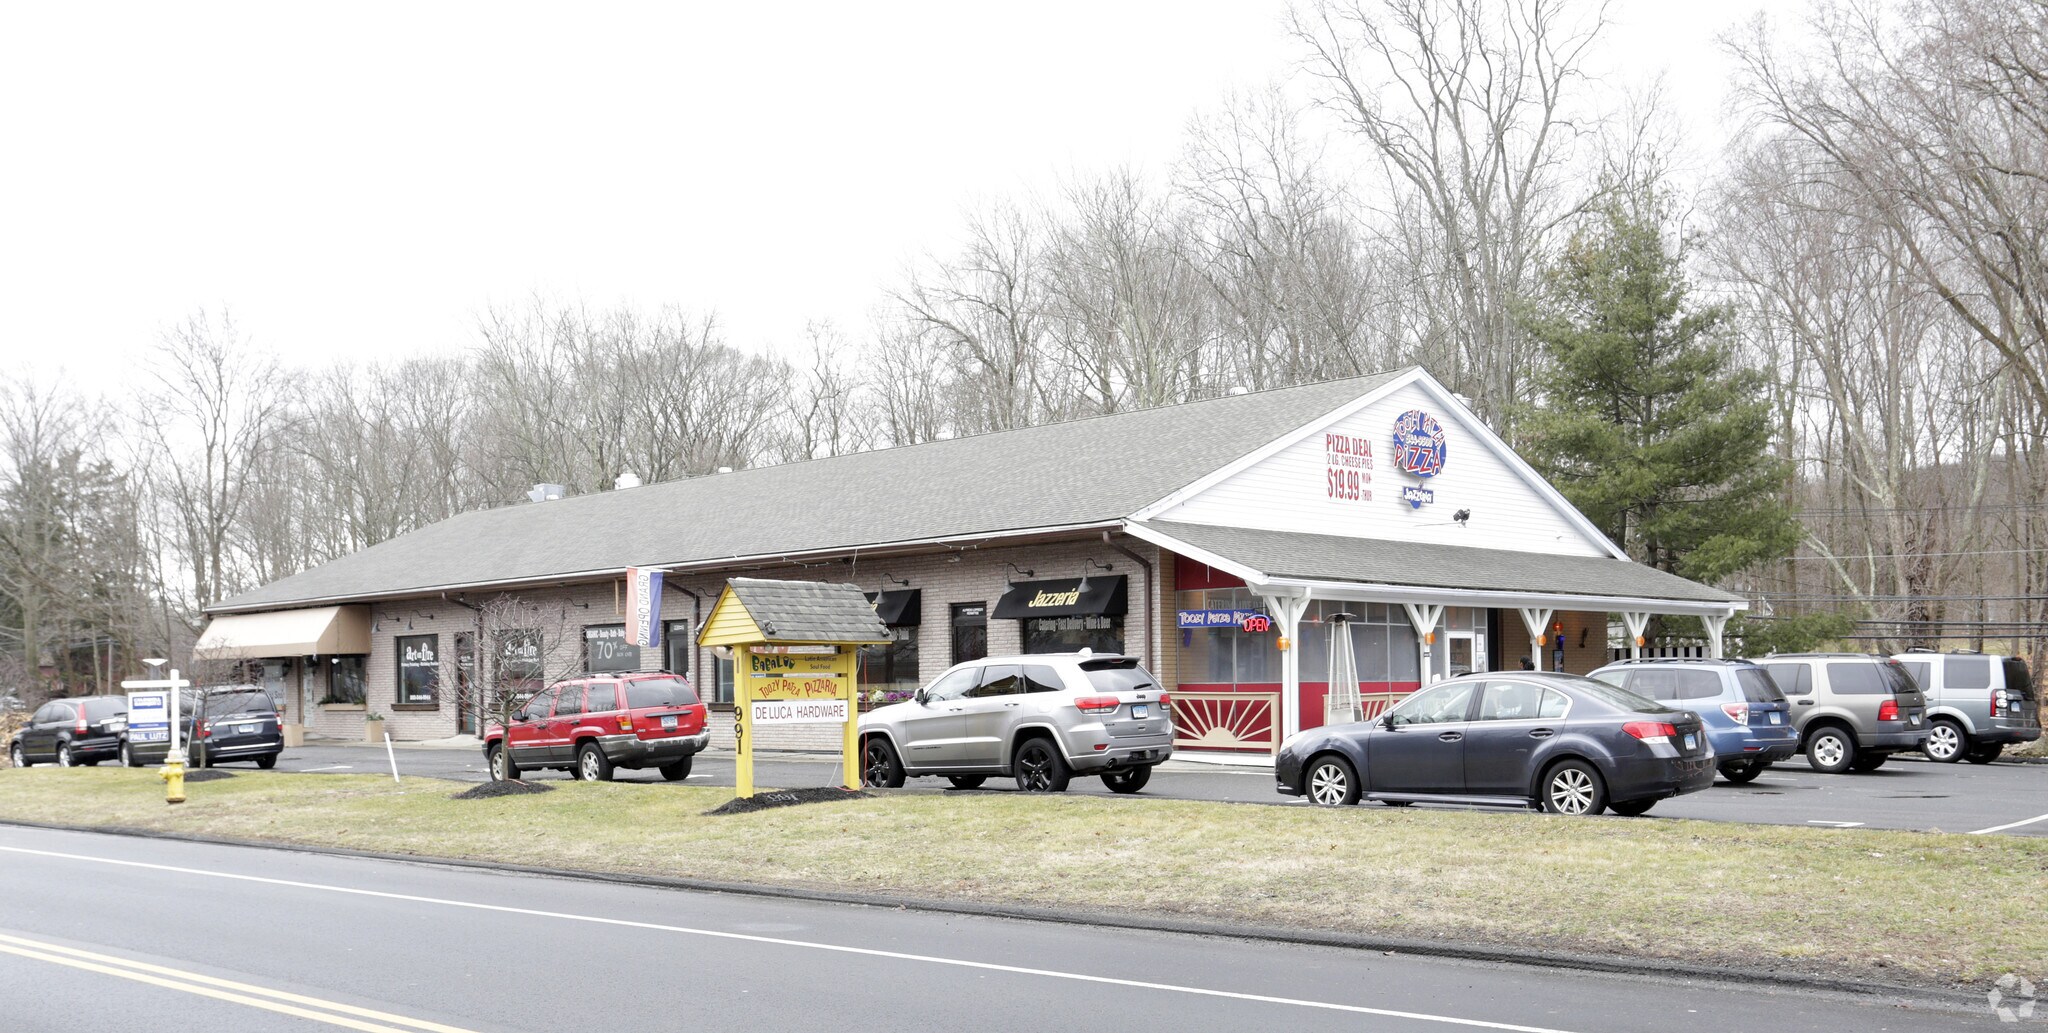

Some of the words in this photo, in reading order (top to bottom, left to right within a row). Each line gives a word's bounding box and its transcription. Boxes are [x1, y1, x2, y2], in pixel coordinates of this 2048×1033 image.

[1326, 433, 1351, 455] PIZZA
[1352, 437, 1373, 457] DEAL
[1327, 453, 1331, 464] 2
[1341, 455, 1361, 469] CHEESE
[1361, 458, 1373, 470] PIES
[1327, 466, 1360, 501] $19.99
[1028, 587, 1080, 608] Jazzeria
[1244, 618, 1269, 632] OPEN
[758, 679, 780, 698] TOOZY
[782, 679, 801, 697] PATZA
[804, 678, 838, 697] PIZZARIA
[755, 706, 767, 720] DE
[769, 705, 793, 720] LUCA
[796, 704, 844, 719] HARDWARE
